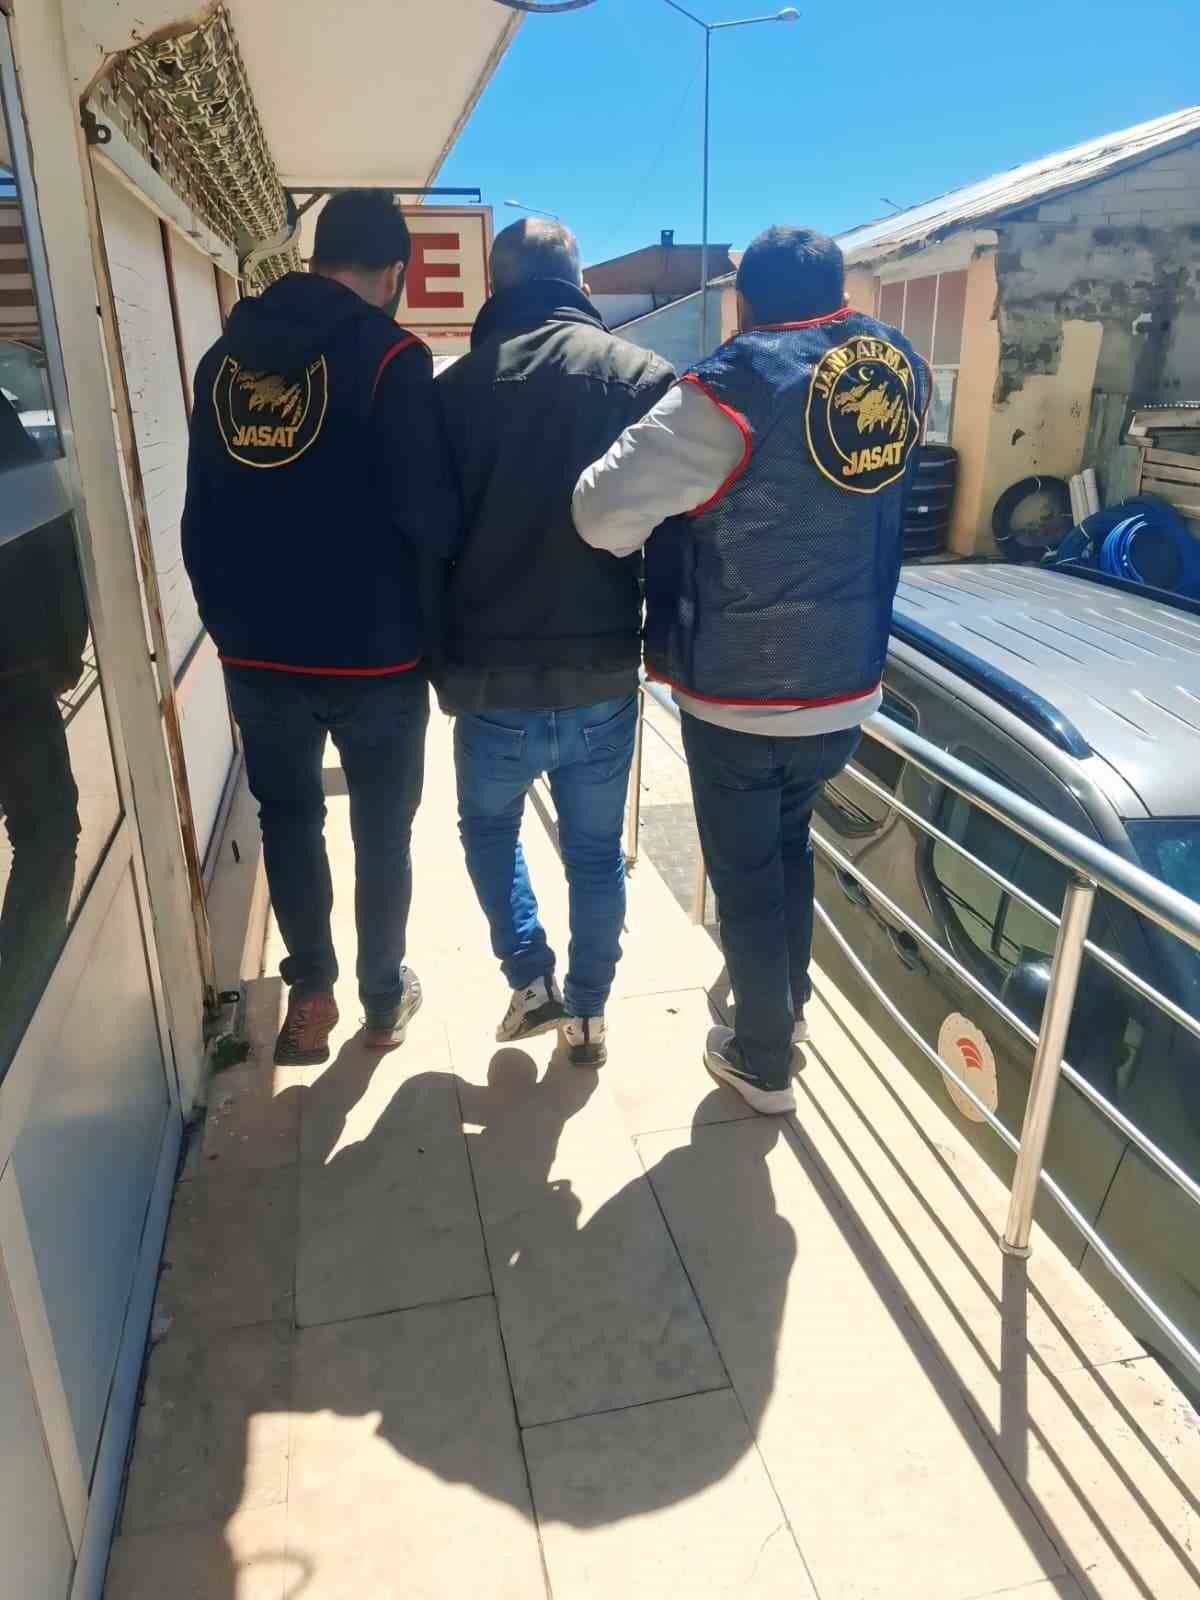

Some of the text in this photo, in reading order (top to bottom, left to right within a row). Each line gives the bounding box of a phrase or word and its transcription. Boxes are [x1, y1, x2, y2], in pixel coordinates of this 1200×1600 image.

[815, 341, 910, 399] JANDARMA
[231, 426, 298, 448] JASAT
[842, 441, 904, 476] JASAT
